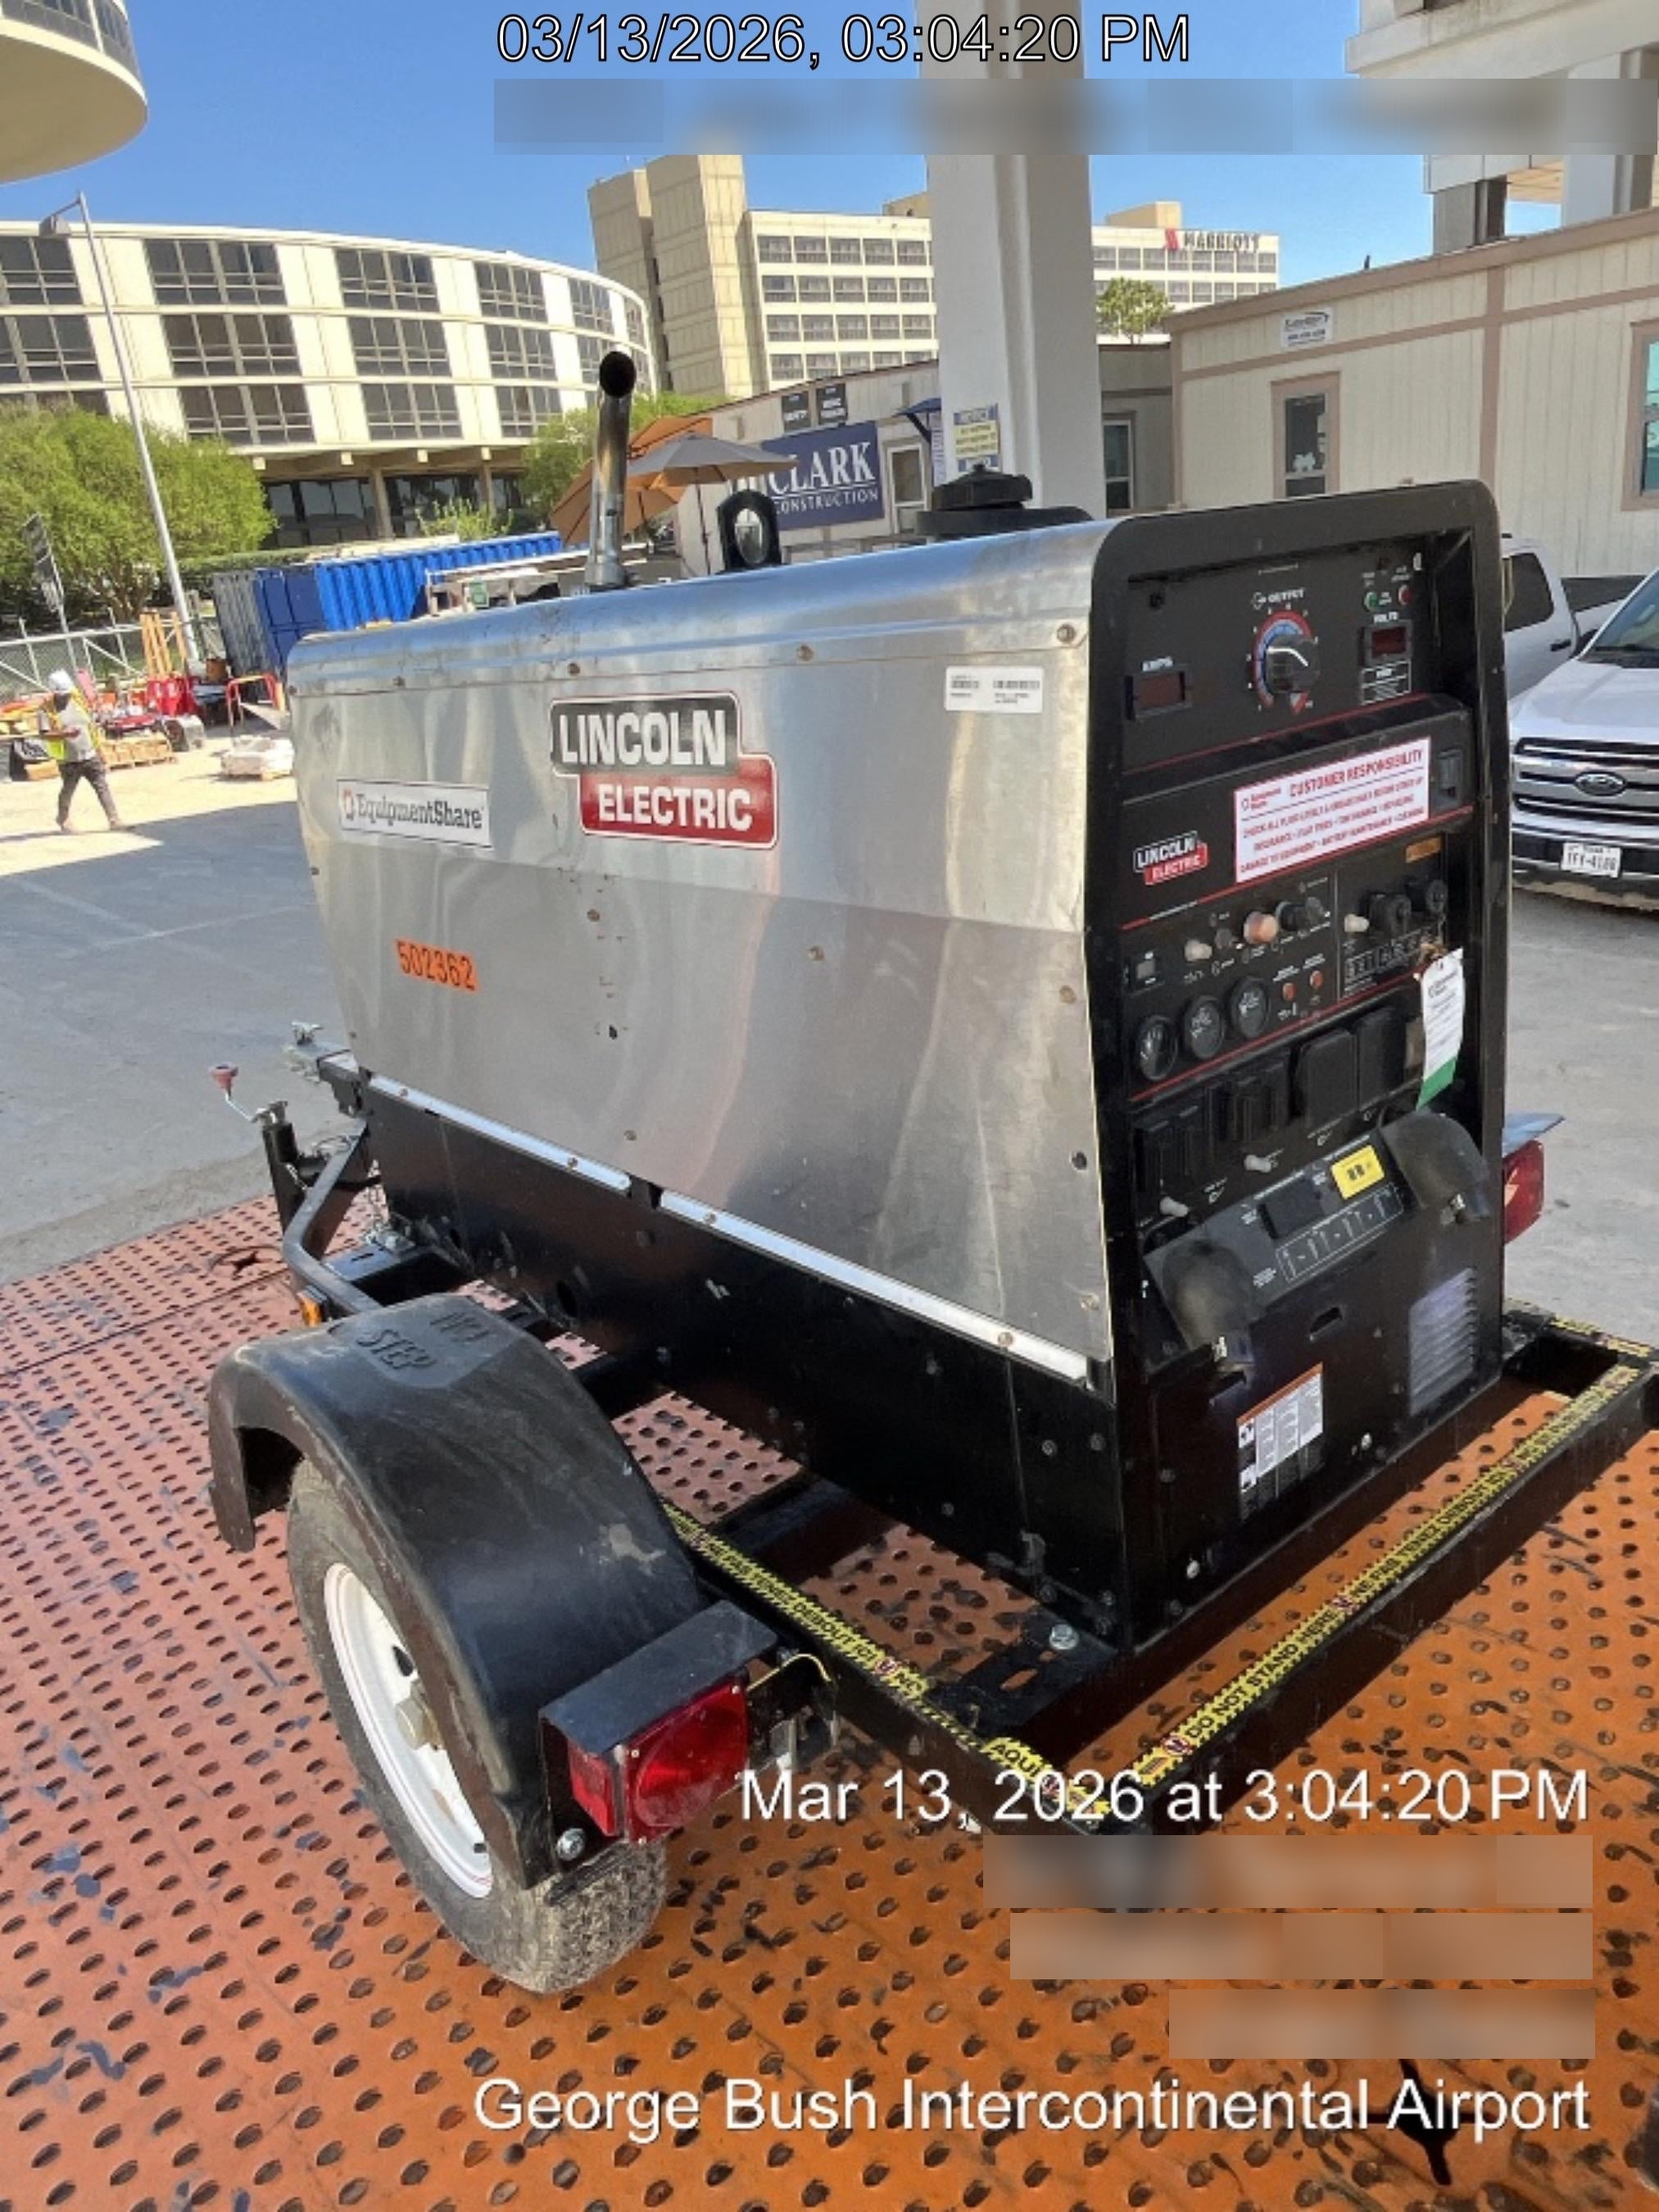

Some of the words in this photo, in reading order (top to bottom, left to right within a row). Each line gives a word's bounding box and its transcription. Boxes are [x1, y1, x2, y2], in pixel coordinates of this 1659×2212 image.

[768, 442, 876, 494] CLARK
[560, 709, 726, 766] LINCOLN
[597, 783, 753, 832] ELECTRIC
[1290, 770, 1345, 797] CUSTOMER
[356, 792, 483, 829] EquipmentShare
[1137, 836, 1196, 869] LINCOLN
[397, 941, 475, 990] 502362
[356, 1329, 437, 1370] STEP
[1185, 1715, 1215, 1739] DO
[1212, 1686, 1249, 1716] NOT
[1245, 1642, 1300, 1688] STAND
